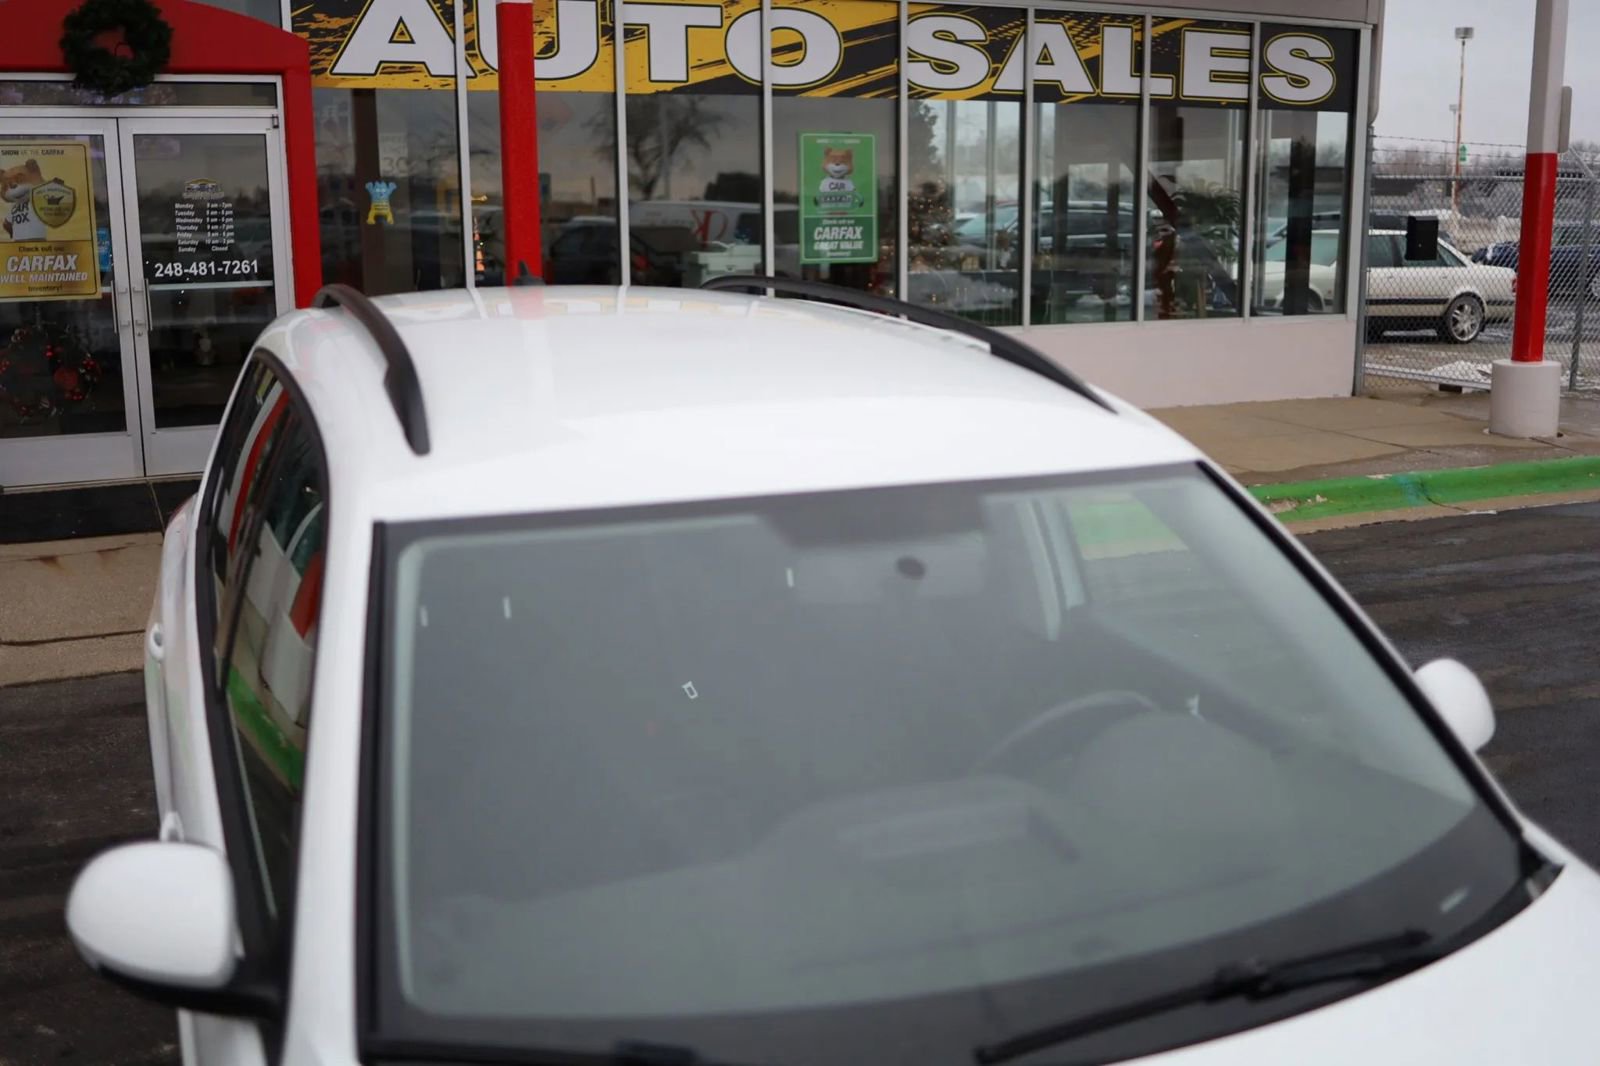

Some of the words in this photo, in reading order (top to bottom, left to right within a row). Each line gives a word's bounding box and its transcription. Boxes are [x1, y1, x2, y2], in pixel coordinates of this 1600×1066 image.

[328, 0, 843, 88] AUTO
[906, 13, 1336, 104] SALES
[814, 227, 863, 240] CARFAX
[7, 254, 78, 272] CARFAX
[154, 259, 259, 278] 248-481-7261
[0, 274, 26, 285] WELL
[30, 272, 88, 284] MAINTAINED
